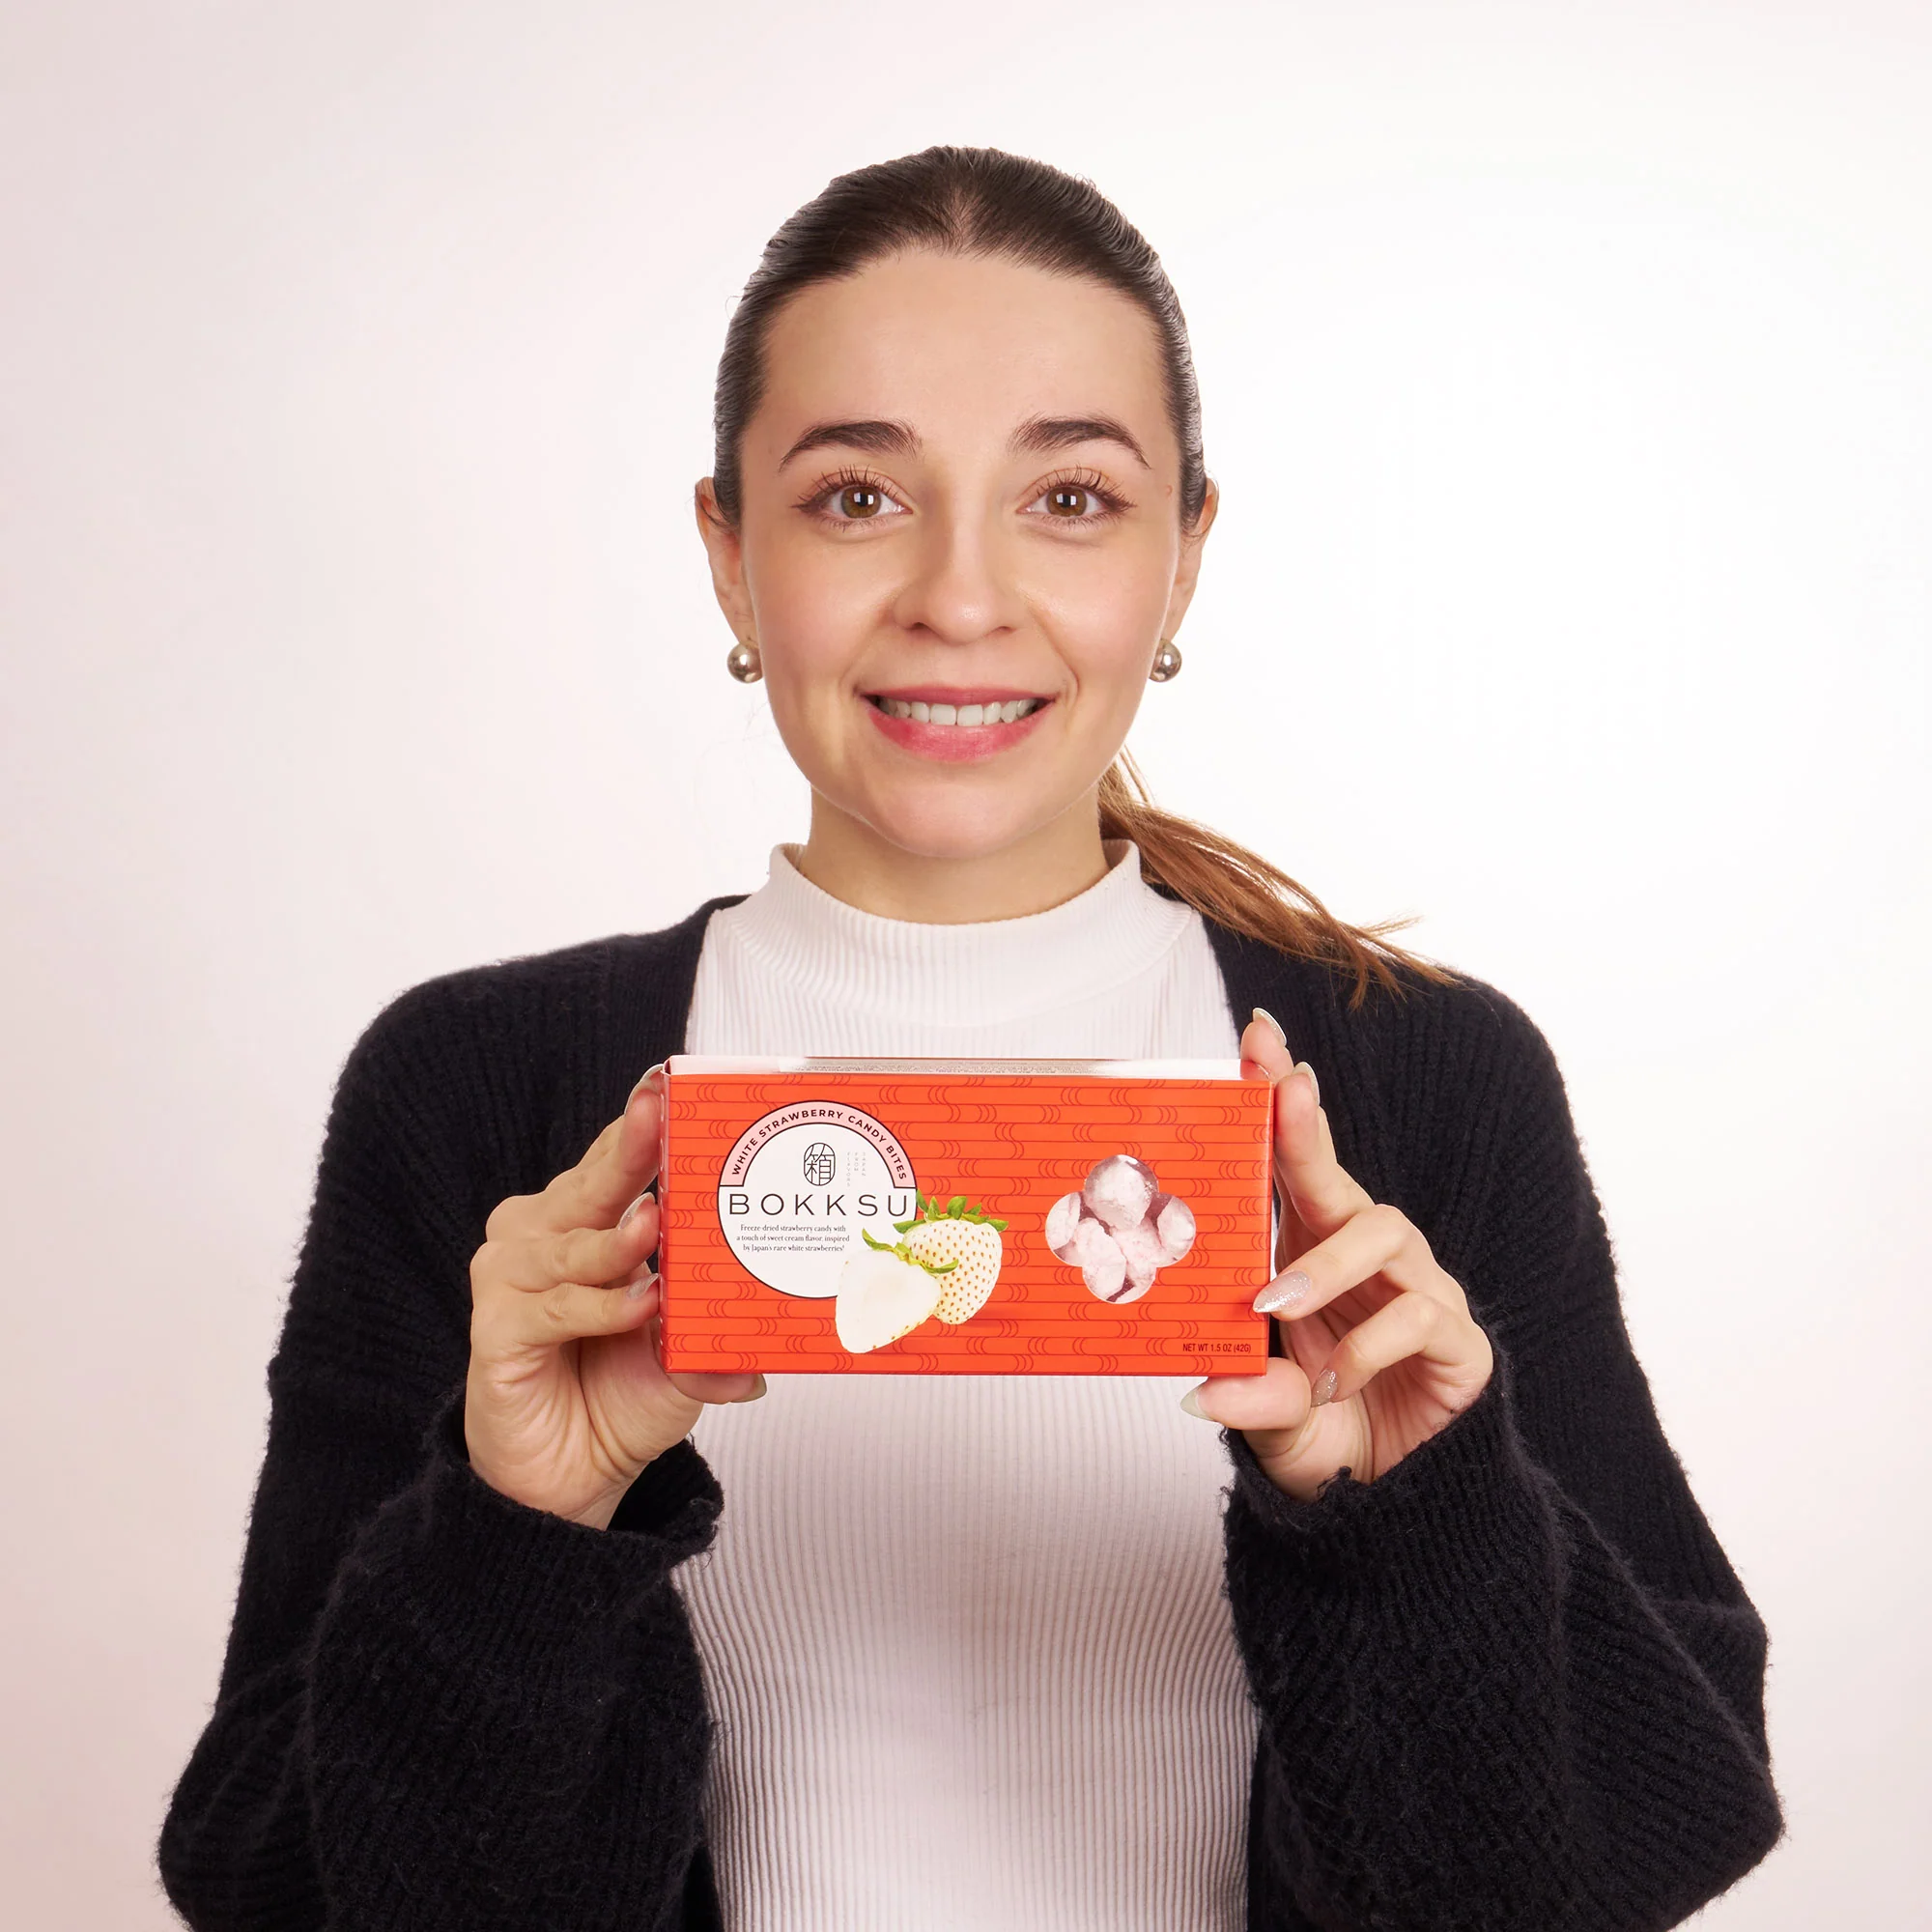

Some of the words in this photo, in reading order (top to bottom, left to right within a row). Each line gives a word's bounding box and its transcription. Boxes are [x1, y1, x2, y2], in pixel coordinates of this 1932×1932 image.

[732, 1138, 758, 1175] WHITE
[758, 1109, 843, 1138] STRAWBERRY
[848, 1115, 887, 1143] CANDY
[886, 1145, 907, 1179] BITES
[729, 1193, 907, 1217] BOKKSU
[780, 1224, 813, 1234] strawberry
[813, 1224, 832, 1234] candy
[824, 1235, 850, 1243] inspired
[743, 1243, 750, 1253] by
[752, 1243, 773, 1253] Japan's
[787, 1243, 804, 1252] white
[1182, 1343, 1196, 1352] NET
[1198, 1343, 1208, 1352] WT
[1210, 1343, 1221, 1352] 1.5
[1222, 1343, 1233, 1352] OZ
[1234, 1343, 1252, 1353] (42G)
